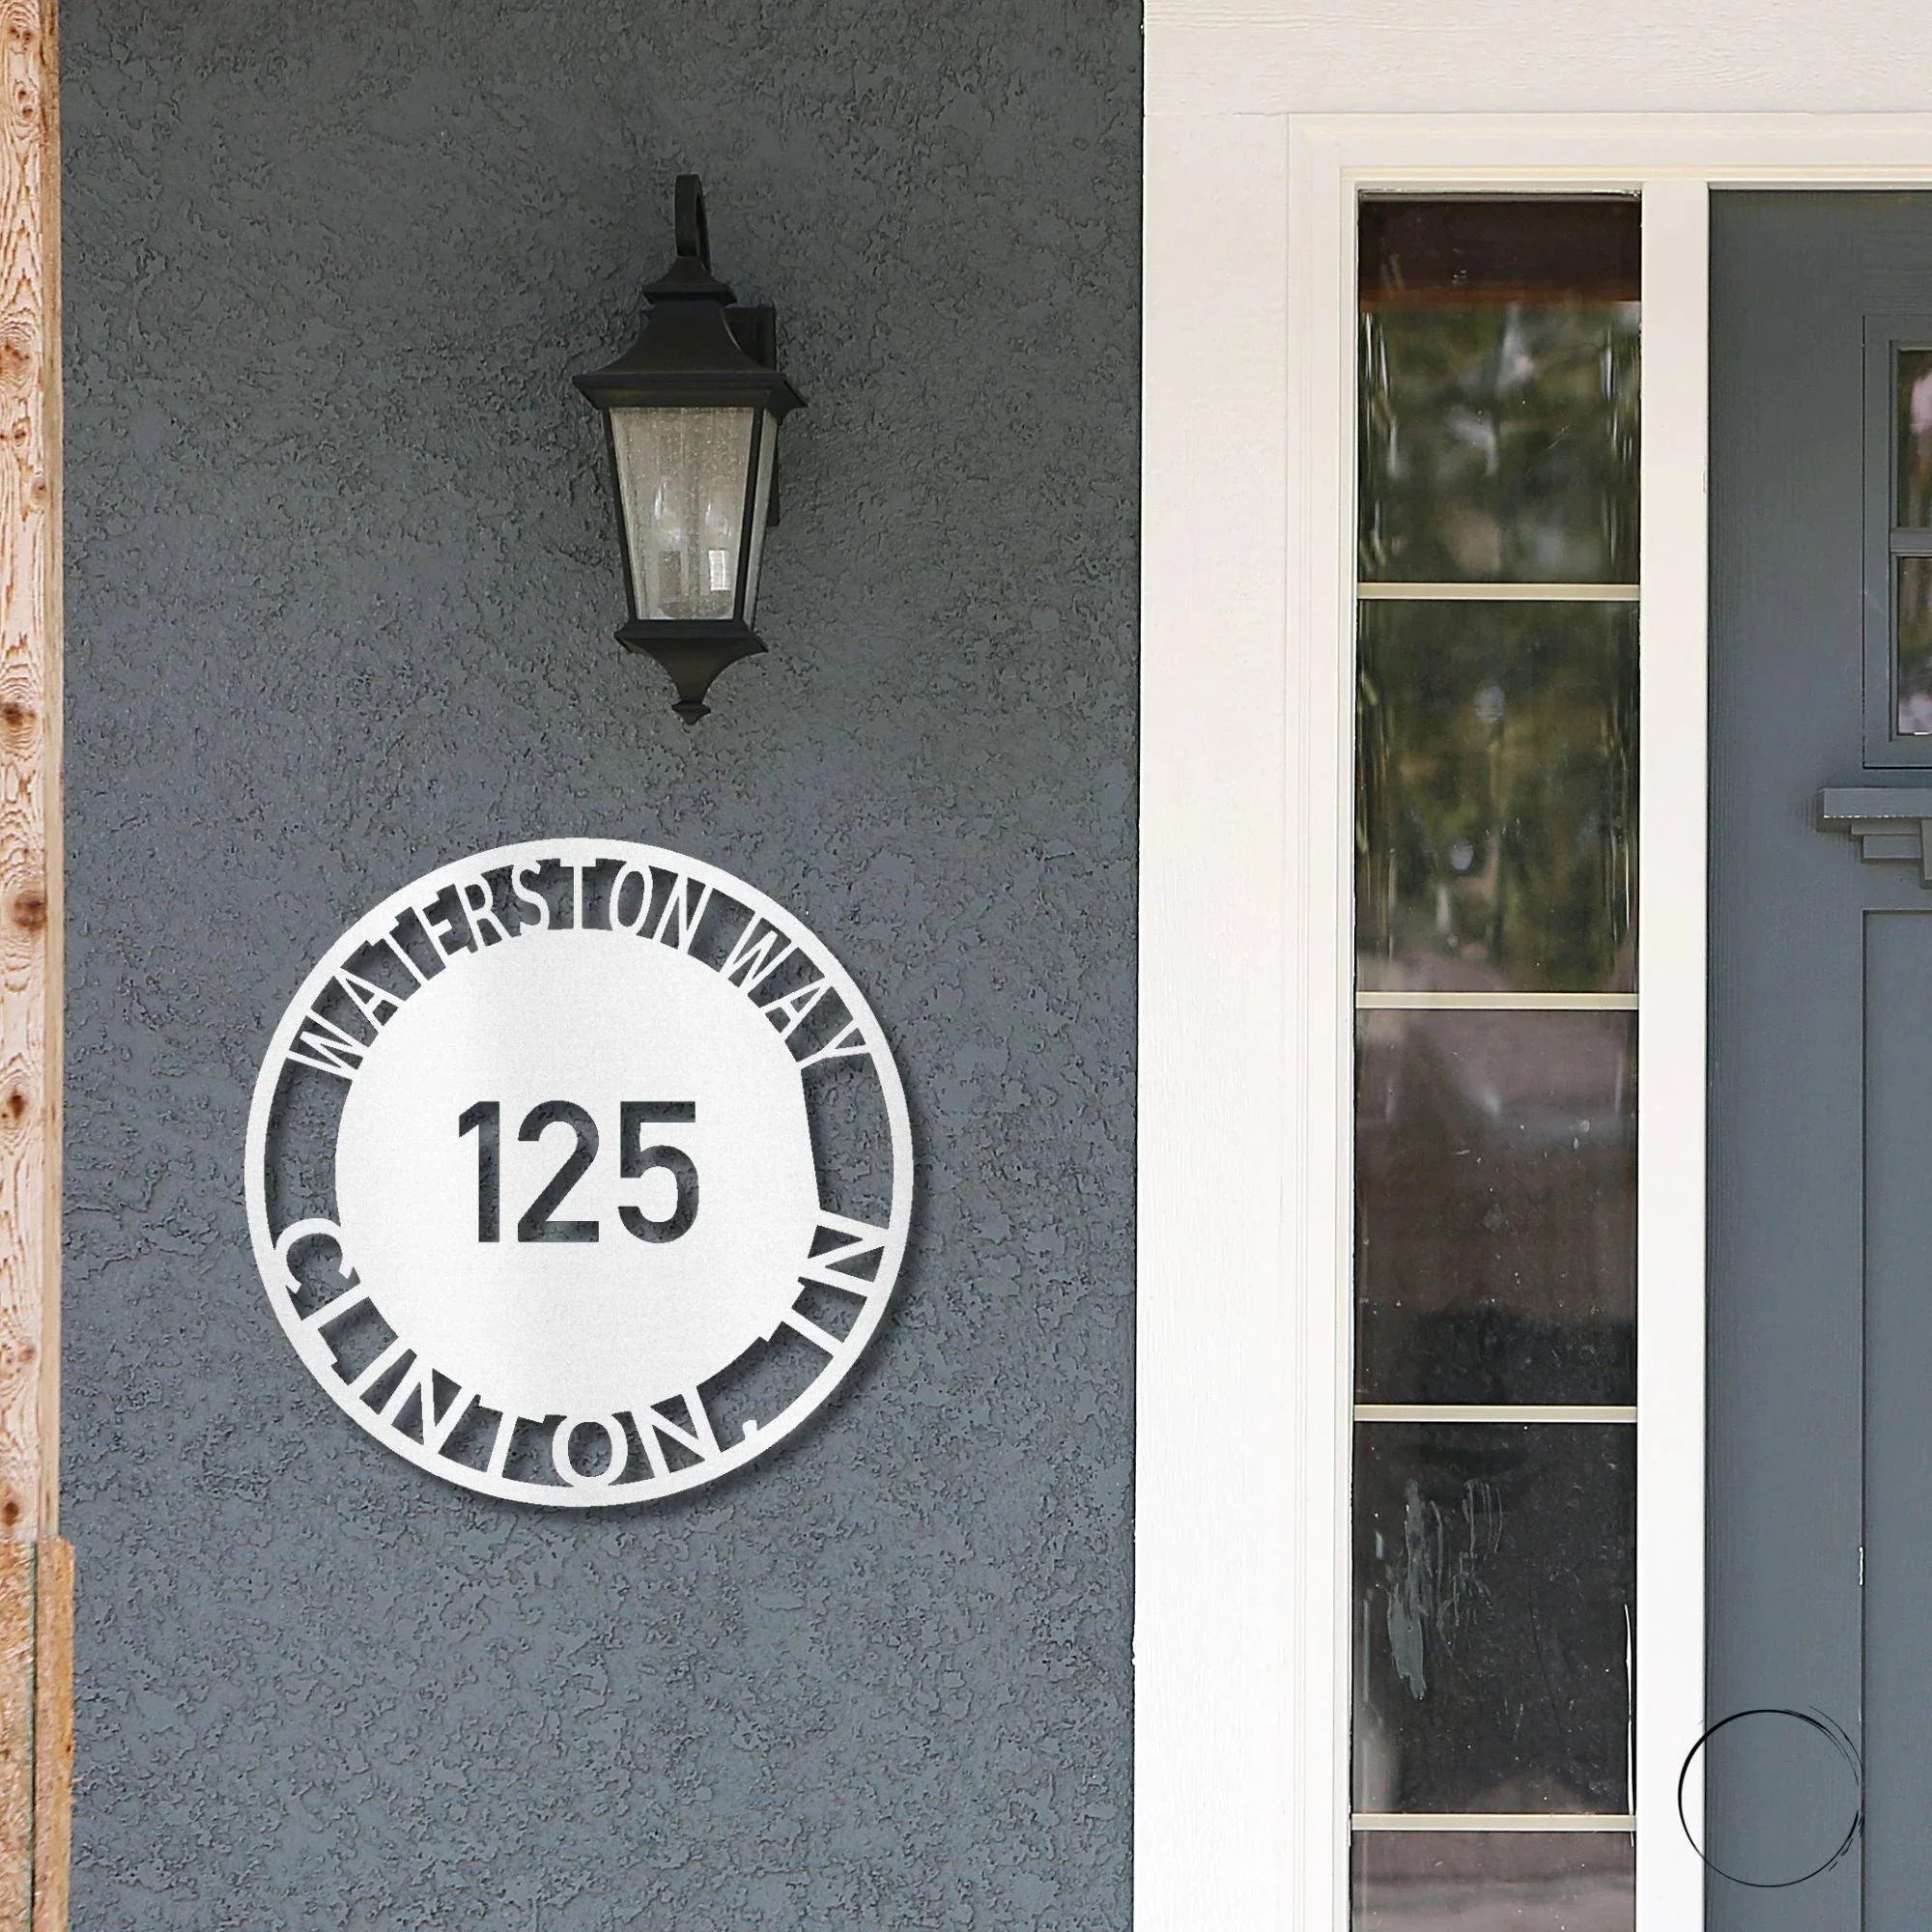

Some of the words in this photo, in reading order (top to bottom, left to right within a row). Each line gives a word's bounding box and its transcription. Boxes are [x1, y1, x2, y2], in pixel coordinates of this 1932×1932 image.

[286, 858, 718, 1081] WATERSTON
[718, 911, 872, 1071] WAY
[458, 1099, 699, 1244] 125
